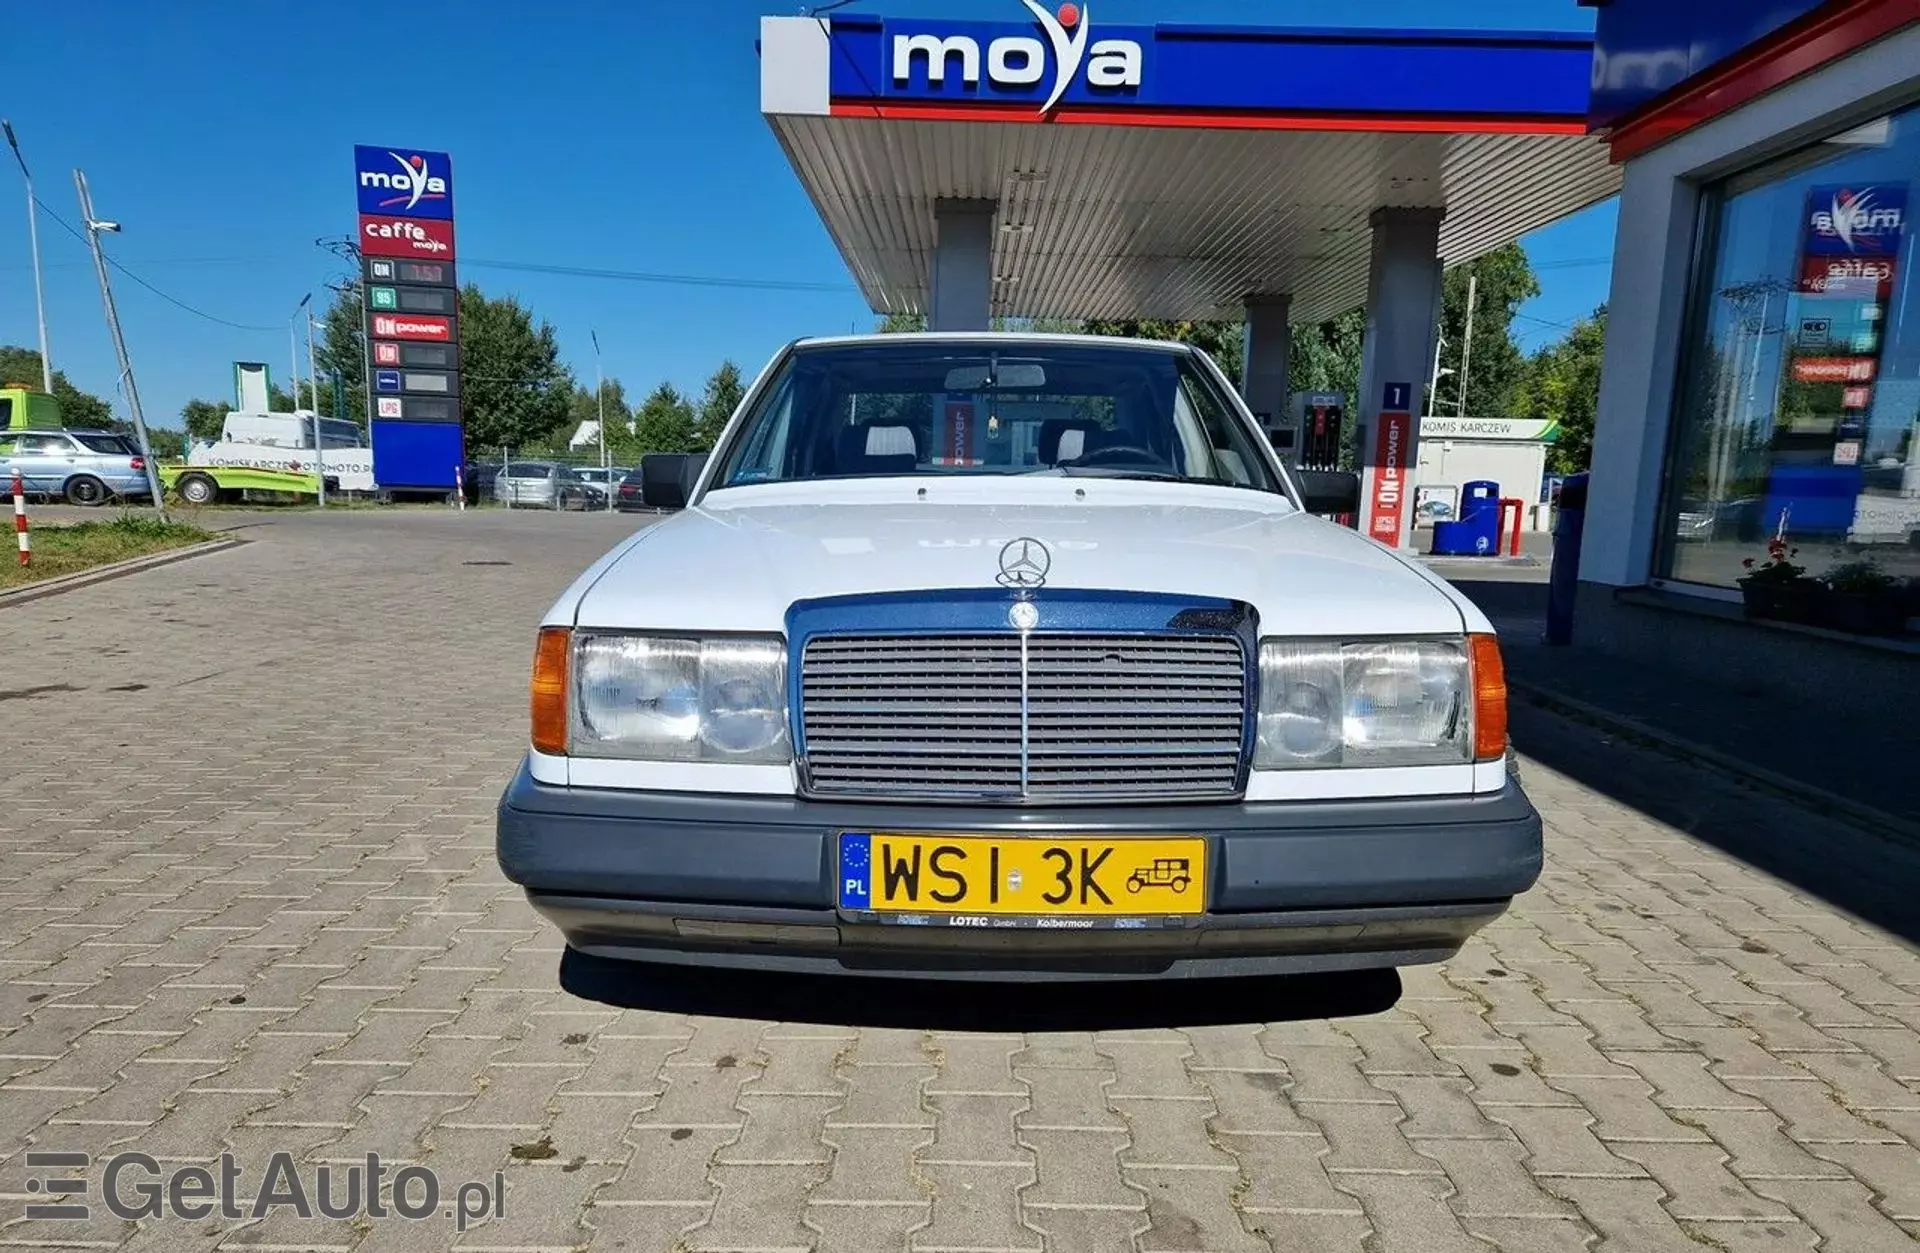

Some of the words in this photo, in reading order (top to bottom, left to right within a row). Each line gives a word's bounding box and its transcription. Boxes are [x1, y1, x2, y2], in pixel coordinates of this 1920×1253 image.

[893, 0, 1142, 115] moya
[360, 151, 446, 210] moya
[365, 221, 426, 241] caffe
[375, 317, 396, 336] ON
[396, 322, 447, 334] power
[1393, 388, 1400, 405] 1
[380, 402, 399, 415] LPG
[1421, 421, 1457, 433] KOMIS
[1460, 421, 1512, 434] KARCZEW
[882, 843, 999, 905] WSI
[1041, 846, 1115, 906] 3K
[845, 879, 867, 896] PL
[949, 916, 989, 927] LOTEC
[1036, 917, 1094, 929] Kolbermoor
